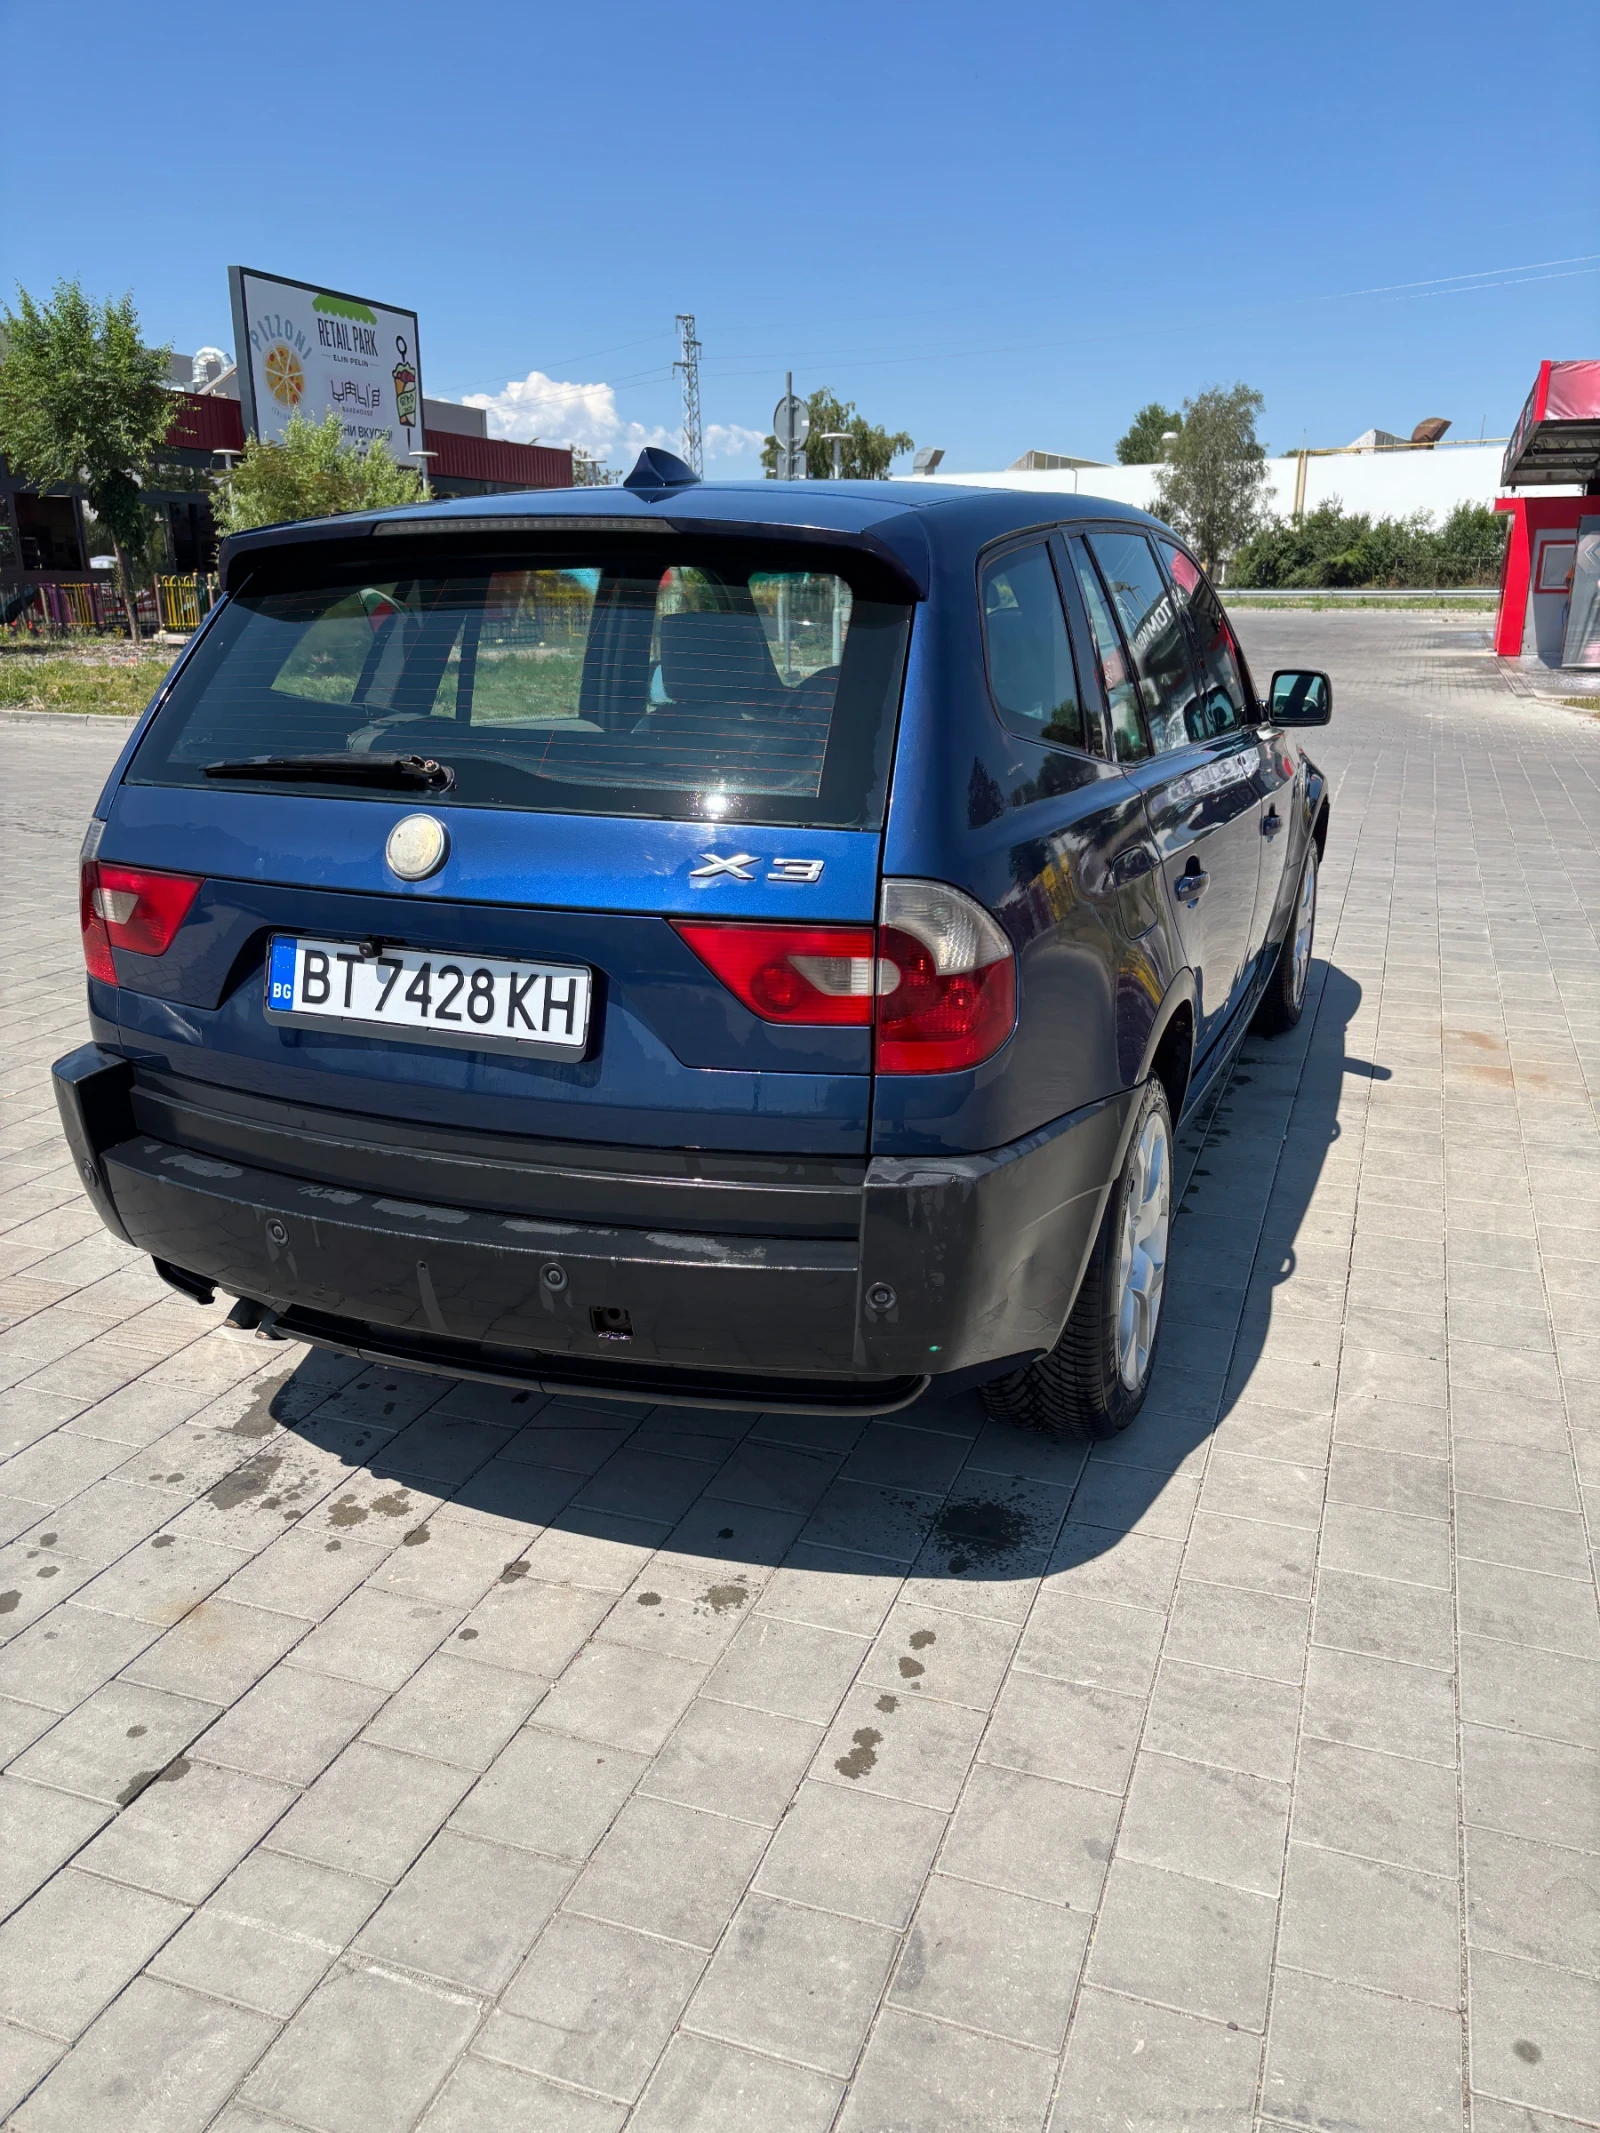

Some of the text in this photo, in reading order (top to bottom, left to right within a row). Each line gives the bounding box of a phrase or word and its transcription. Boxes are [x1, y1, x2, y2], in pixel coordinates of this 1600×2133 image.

[249, 314, 313, 361] PIZZONI
[317, 318, 378, 358] RETAIL PARK
[332, 354, 369, 368] ELIN PELIN
[273, 983, 292, 1000] BG
[302, 950, 577, 1035] BT 7428 KH
